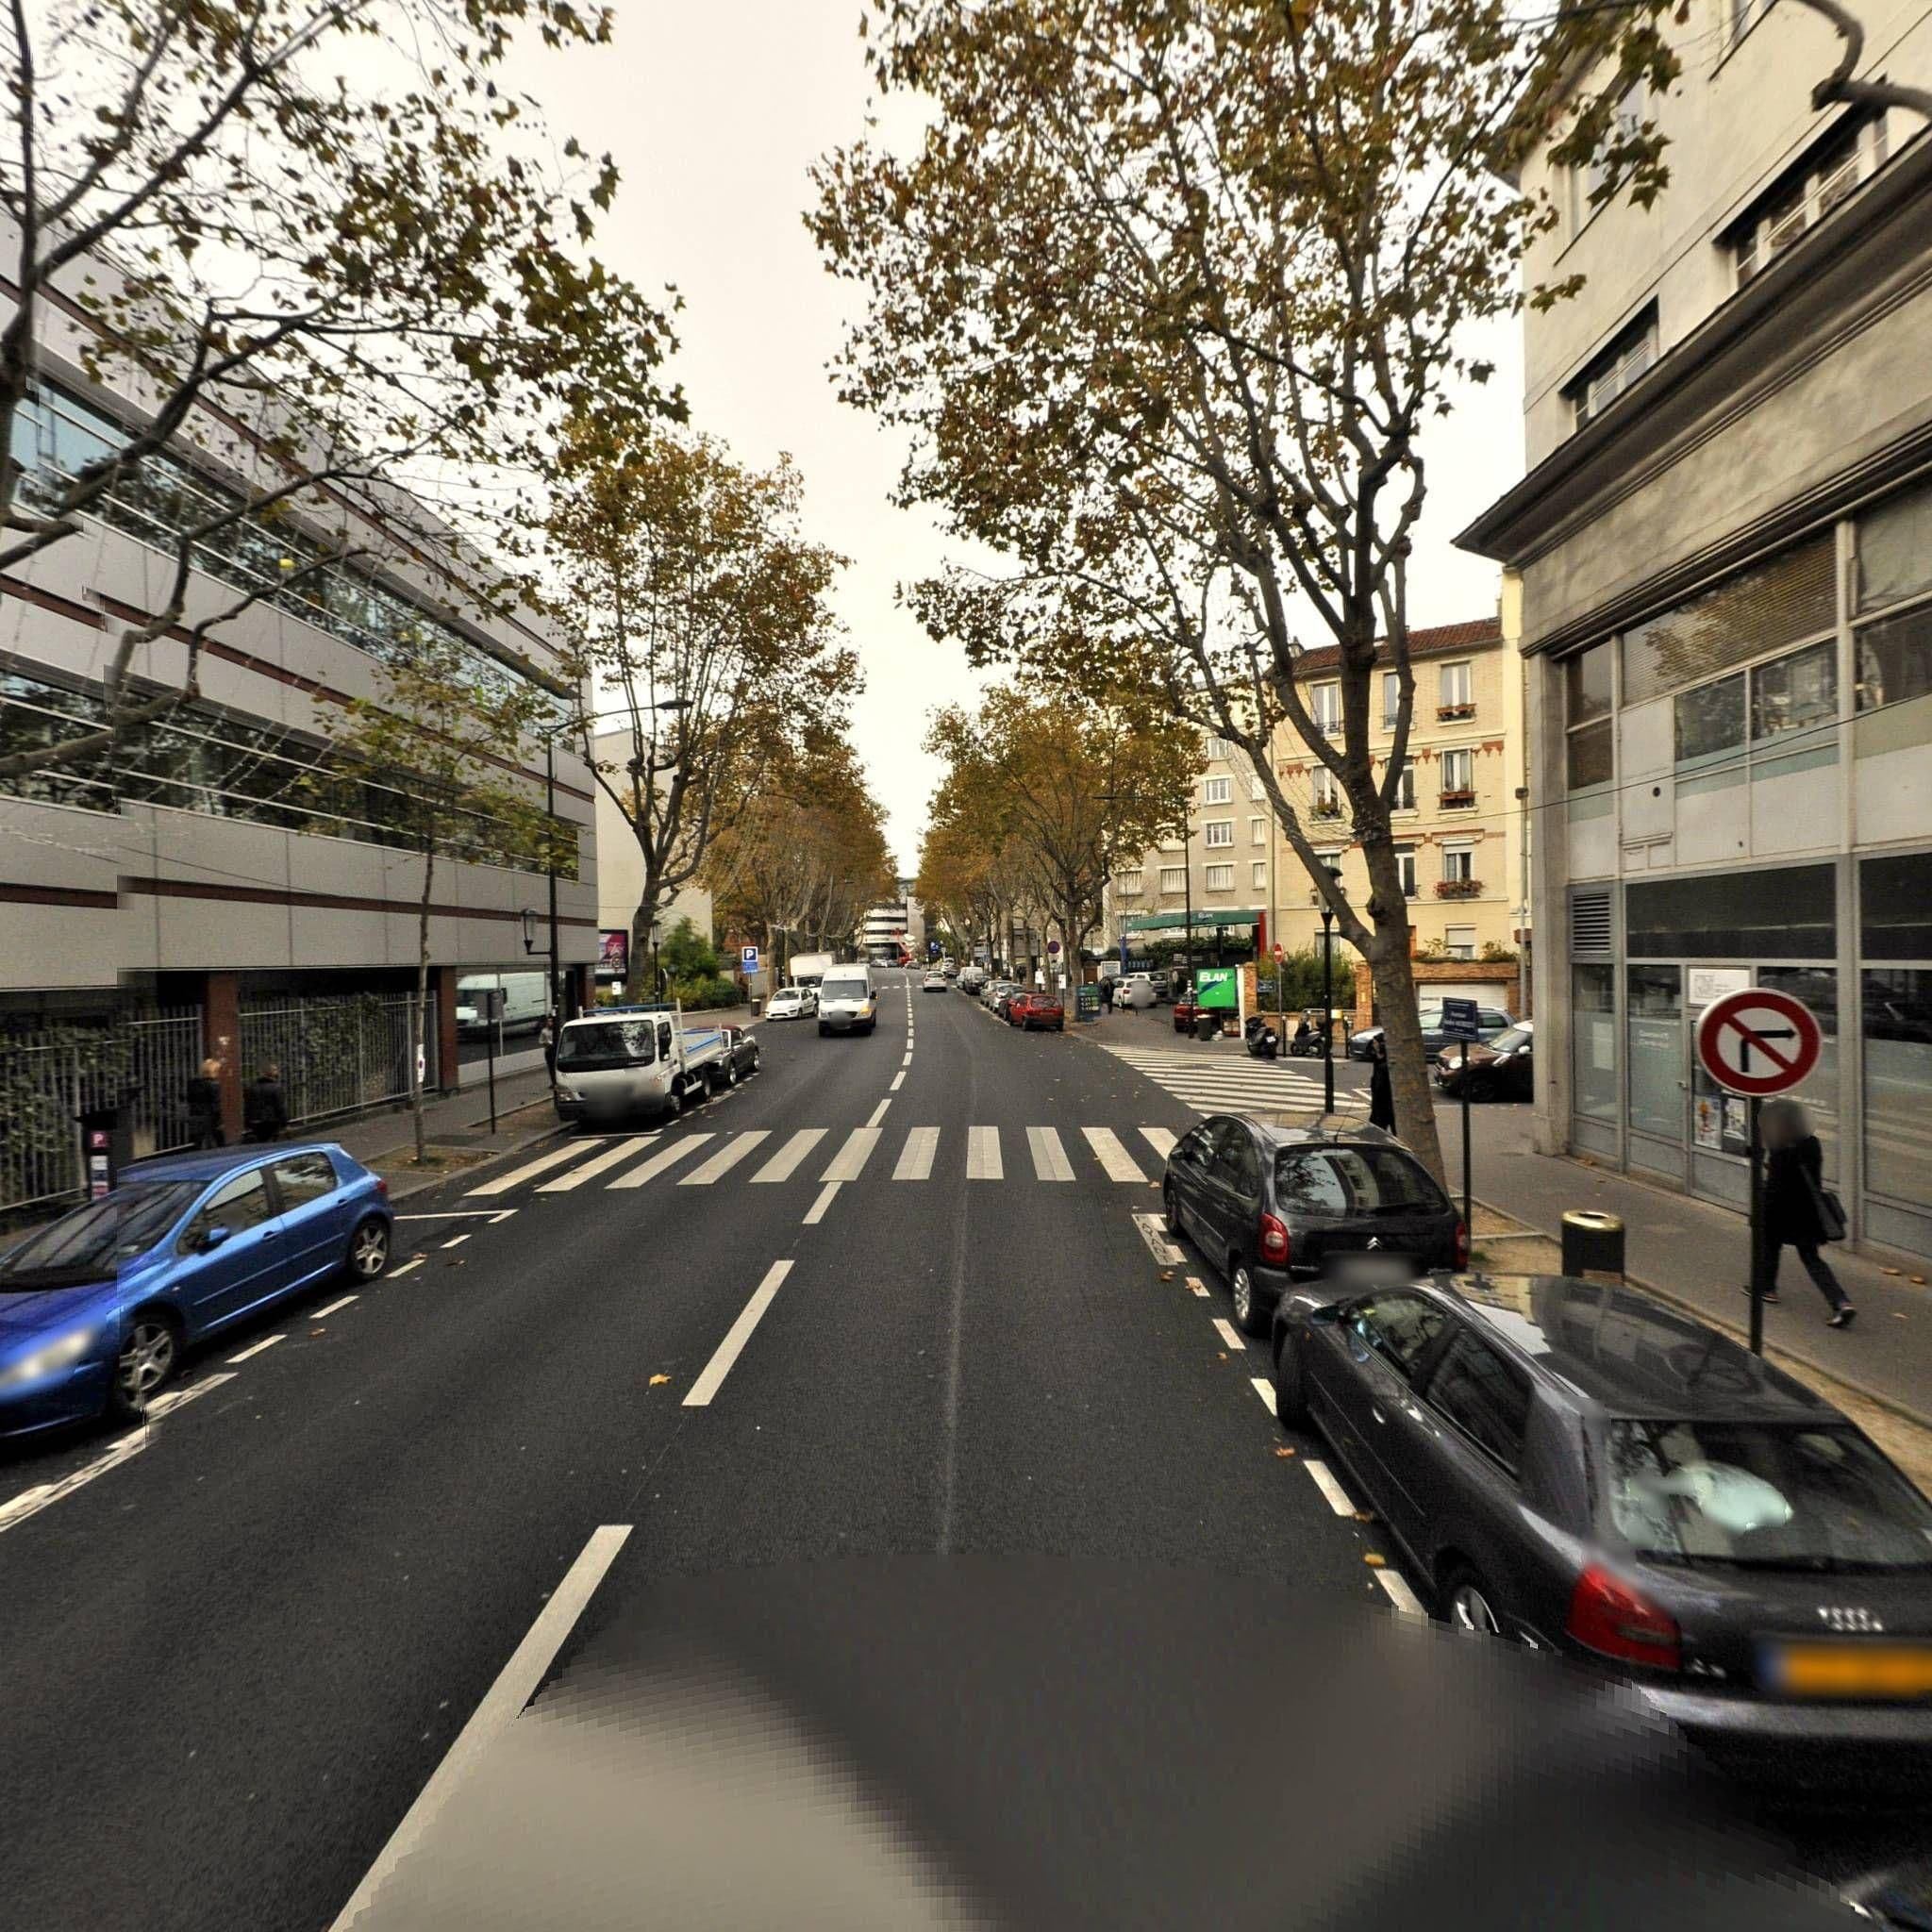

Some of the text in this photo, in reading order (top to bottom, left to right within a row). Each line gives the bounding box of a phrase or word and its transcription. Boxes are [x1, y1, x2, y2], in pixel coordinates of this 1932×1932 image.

[746, 949, 755, 959] P
[1199, 972, 1228, 982] ELAN
[93, 1134, 104, 1144] P
